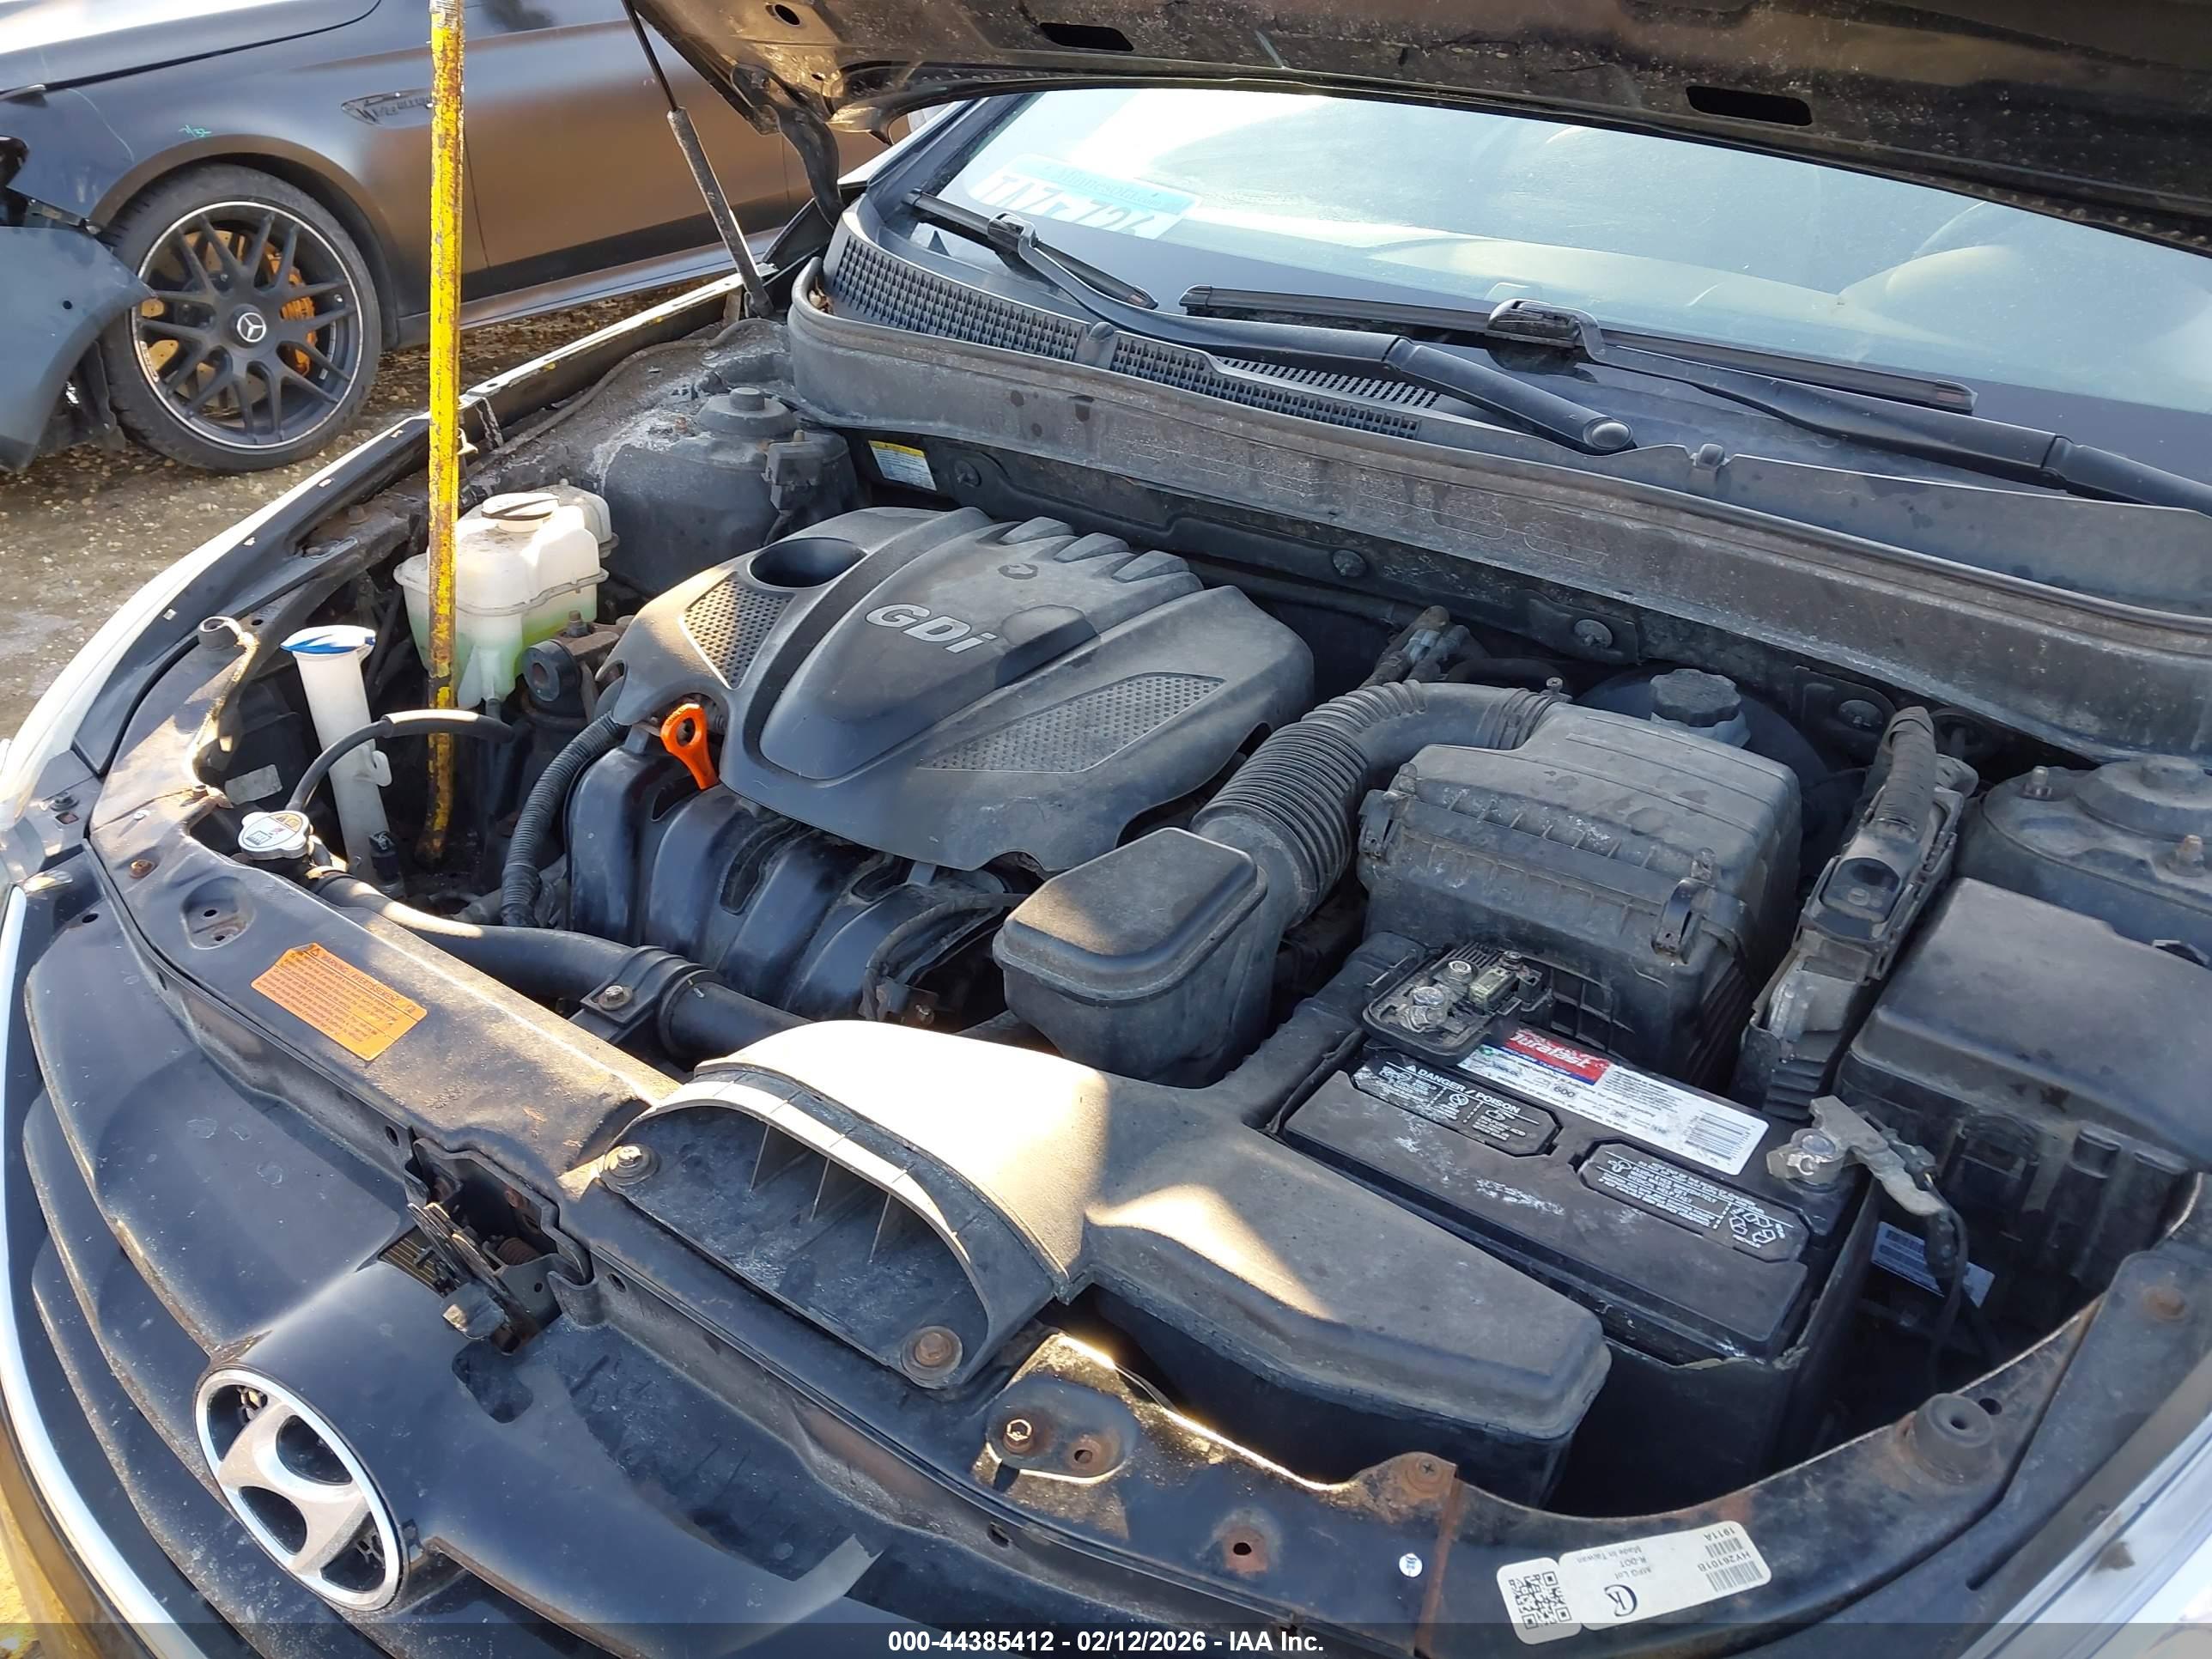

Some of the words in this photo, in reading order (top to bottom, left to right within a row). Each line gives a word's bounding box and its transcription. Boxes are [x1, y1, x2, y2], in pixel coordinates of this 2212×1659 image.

[865, 603, 999, 654] GDi
[1417, 1069, 1466, 1092] DANGER
[1475, 1091, 1521, 1114] POISON
[1553, 1085, 1576, 1098] 600
